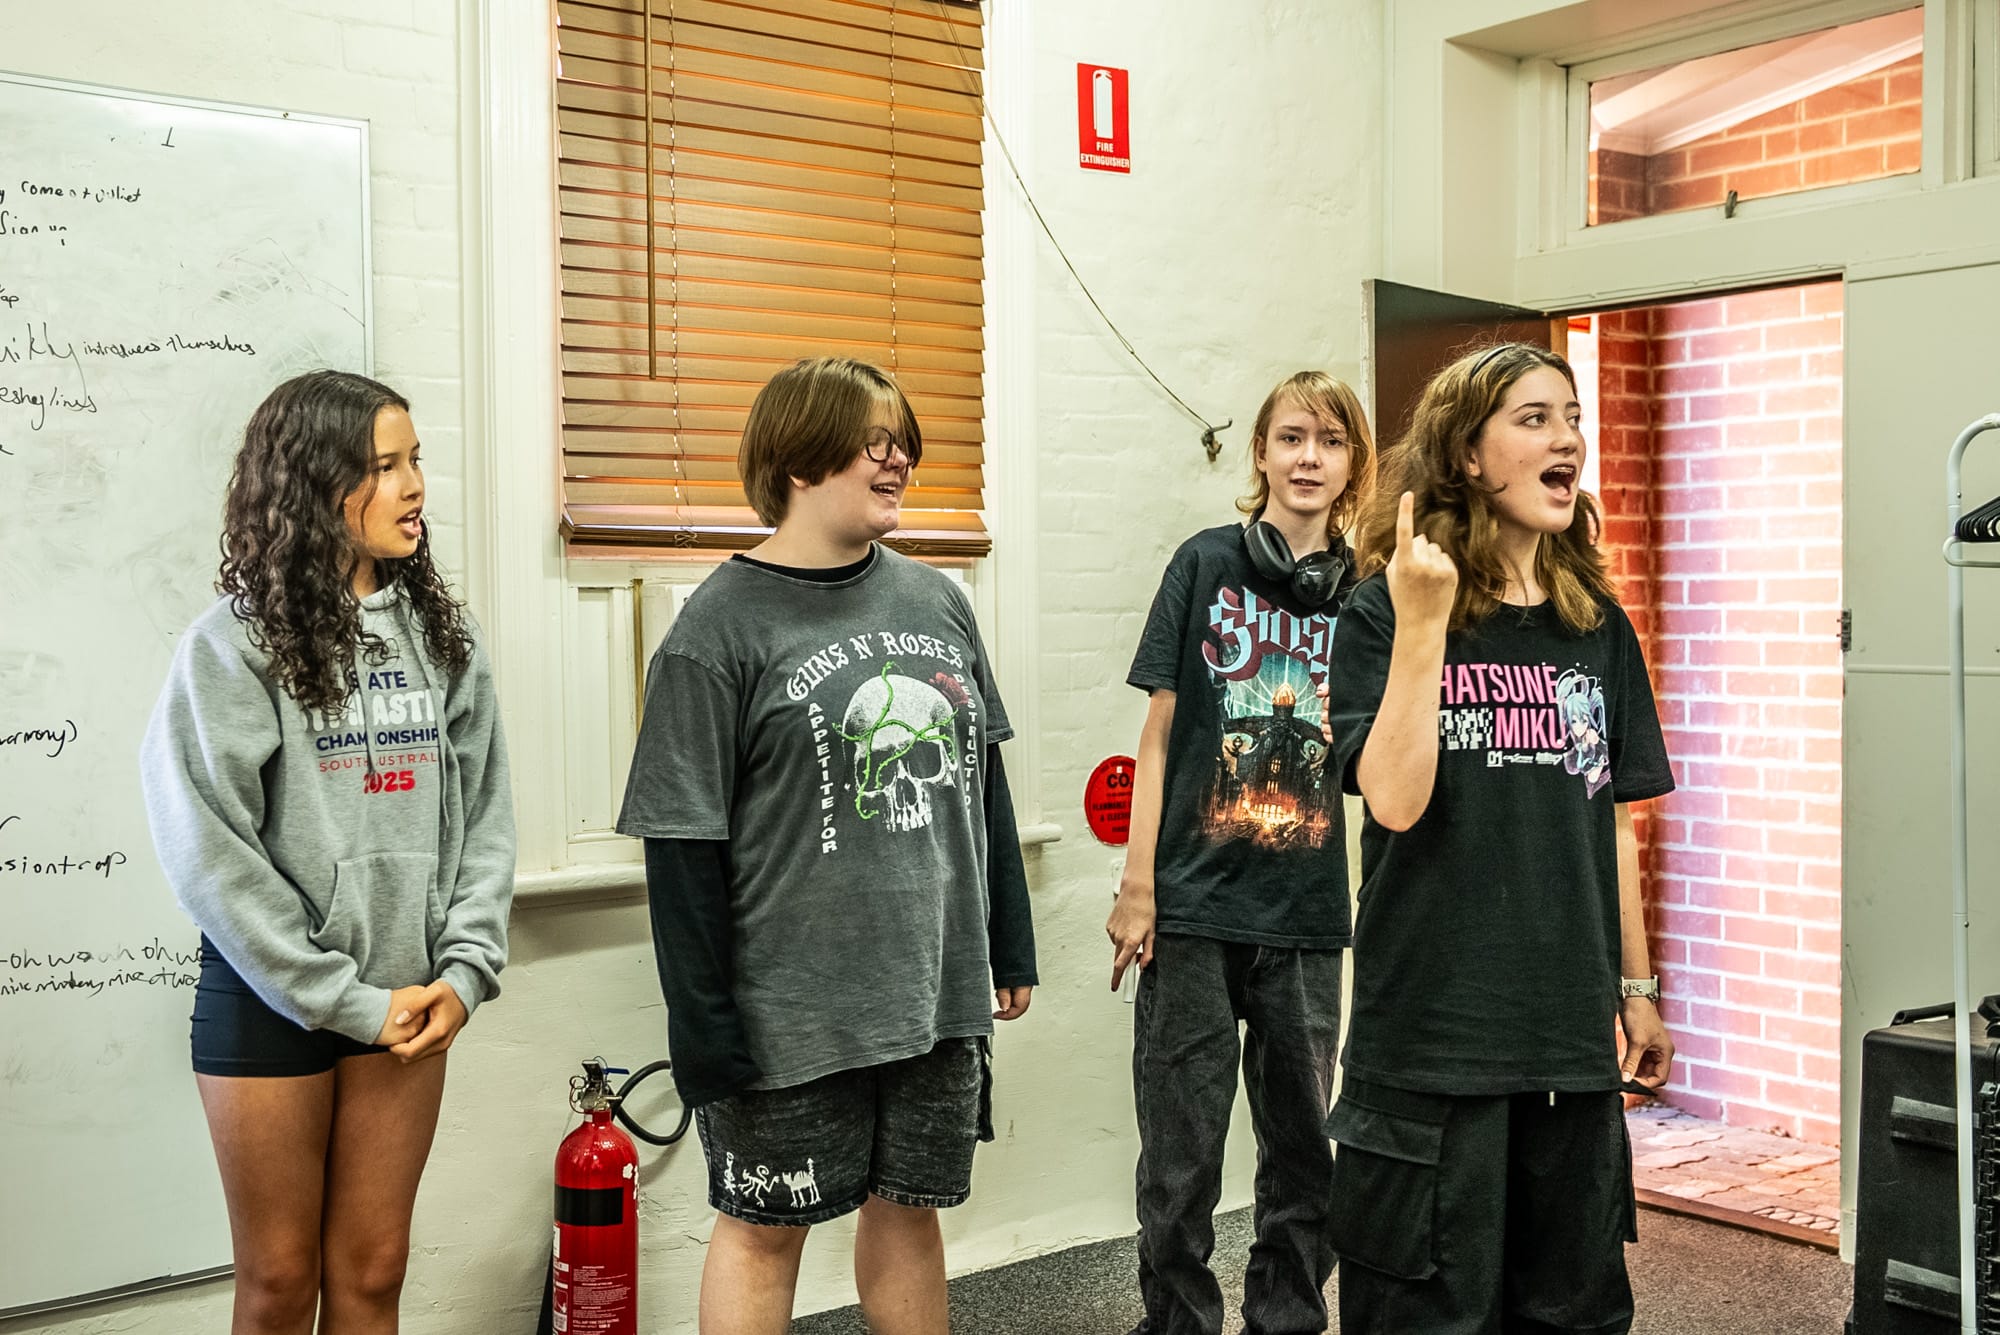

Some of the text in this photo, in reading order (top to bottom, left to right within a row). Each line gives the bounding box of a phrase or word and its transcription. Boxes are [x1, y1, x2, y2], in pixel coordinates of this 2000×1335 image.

[1096, 141, 1114, 153] FIRE
[1080, 153, 1130, 168] EXTINGUISHER
[786, 642, 850, 701] GUNS
[878, 631, 964, 670] ROSES
[1440, 663, 1559, 704] HATSUNE
[316, 728, 439, 751] CHAMONSHIP
[1495, 707, 1566, 749] MIKU
[376, 752, 438, 766] USTRAL
[807, 702, 838, 854] APPETITE FOR
[1106, 772, 1134, 789] CO
